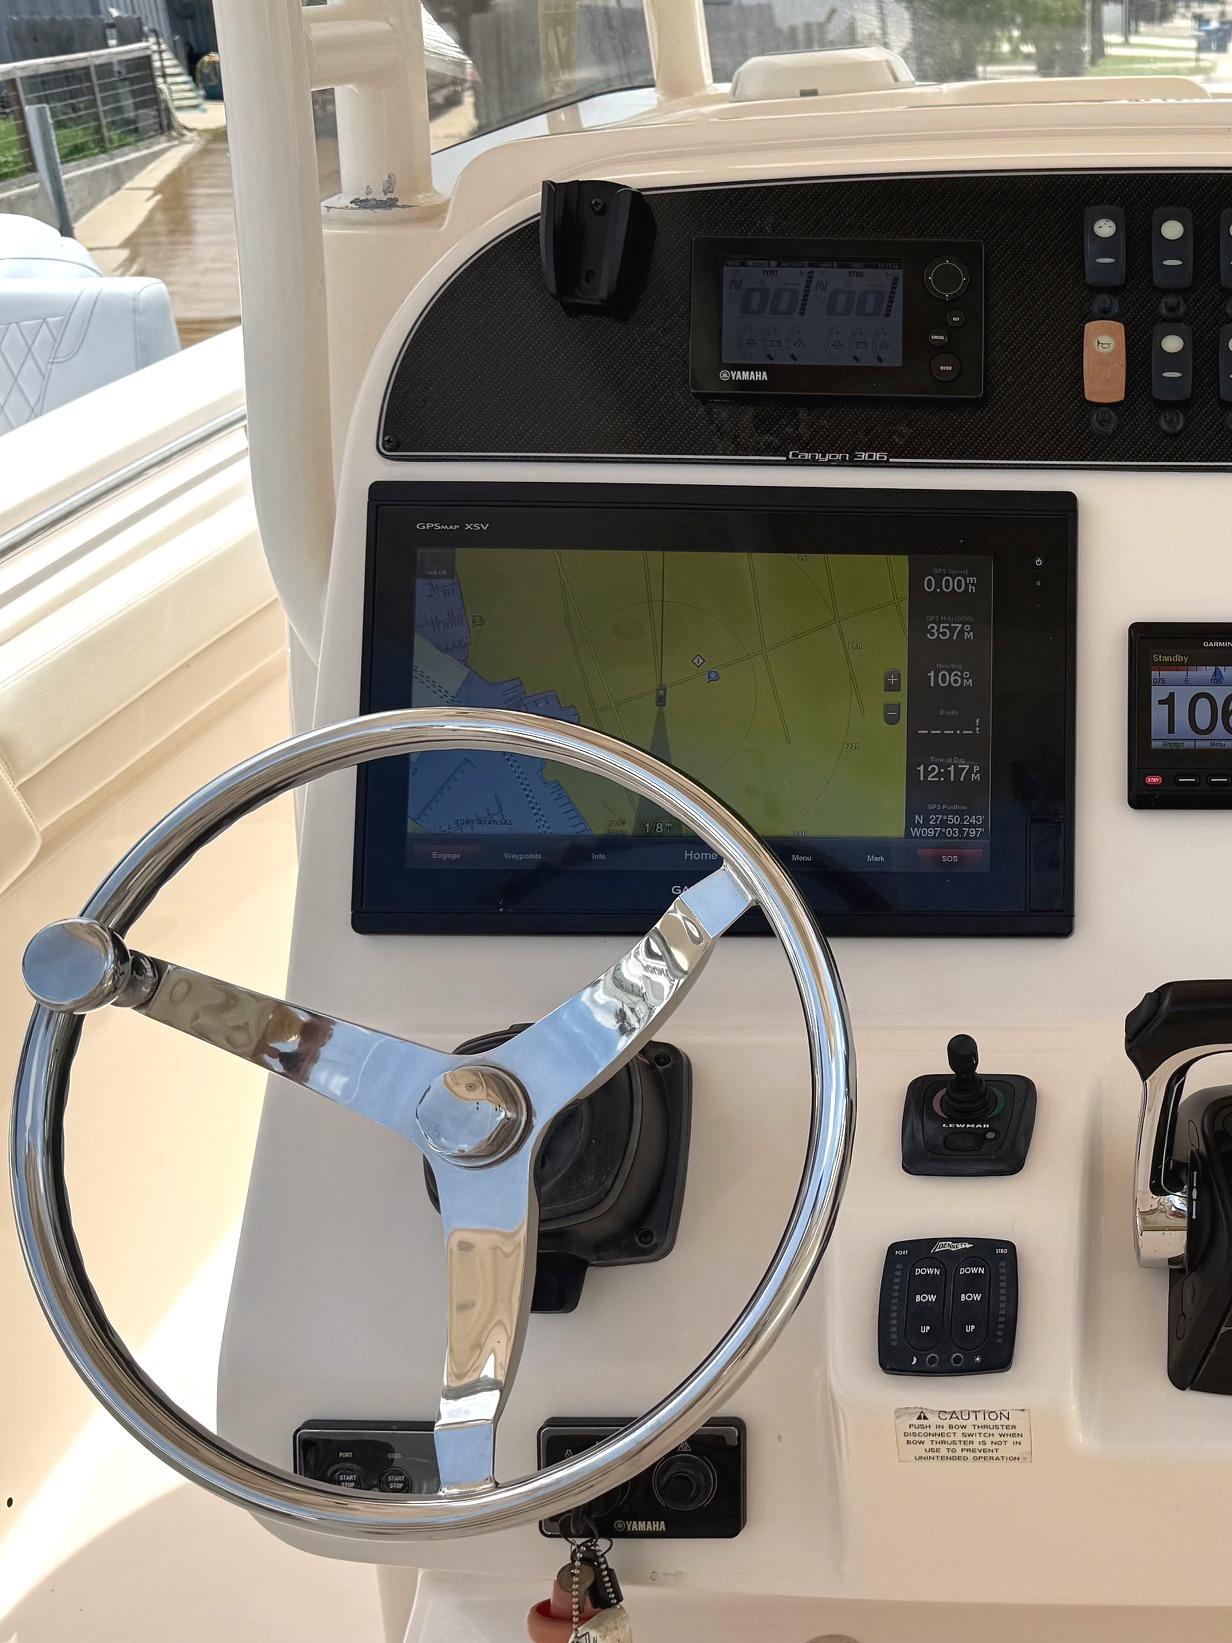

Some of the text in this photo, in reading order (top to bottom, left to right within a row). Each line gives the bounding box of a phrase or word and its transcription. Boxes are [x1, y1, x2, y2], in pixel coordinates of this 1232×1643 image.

[730, 371, 768, 381] YAMAHA
[788, 450, 888, 462] Canyon 306
[464, 523, 490, 531] XSV
[923, 576, 965, 593] 0.00
[1152, 654, 1189, 664] Standby
[916, 764, 970, 782] 12:17
[915, 815, 923, 825] N
[432, 850, 958, 863] Engage Waypoints Info Home Menu Mark SOS
[915, 1268, 940, 1276] DOWN
[915, 1294, 937, 1303] BOW
[960, 1293, 982, 1302] BOW
[920, 1325, 931, 1333] UP
[965, 1325, 975, 1333] UP
[938, 1410, 1010, 1421] CAUTION
[626, 1521, 666, 1531] YAMAHA
